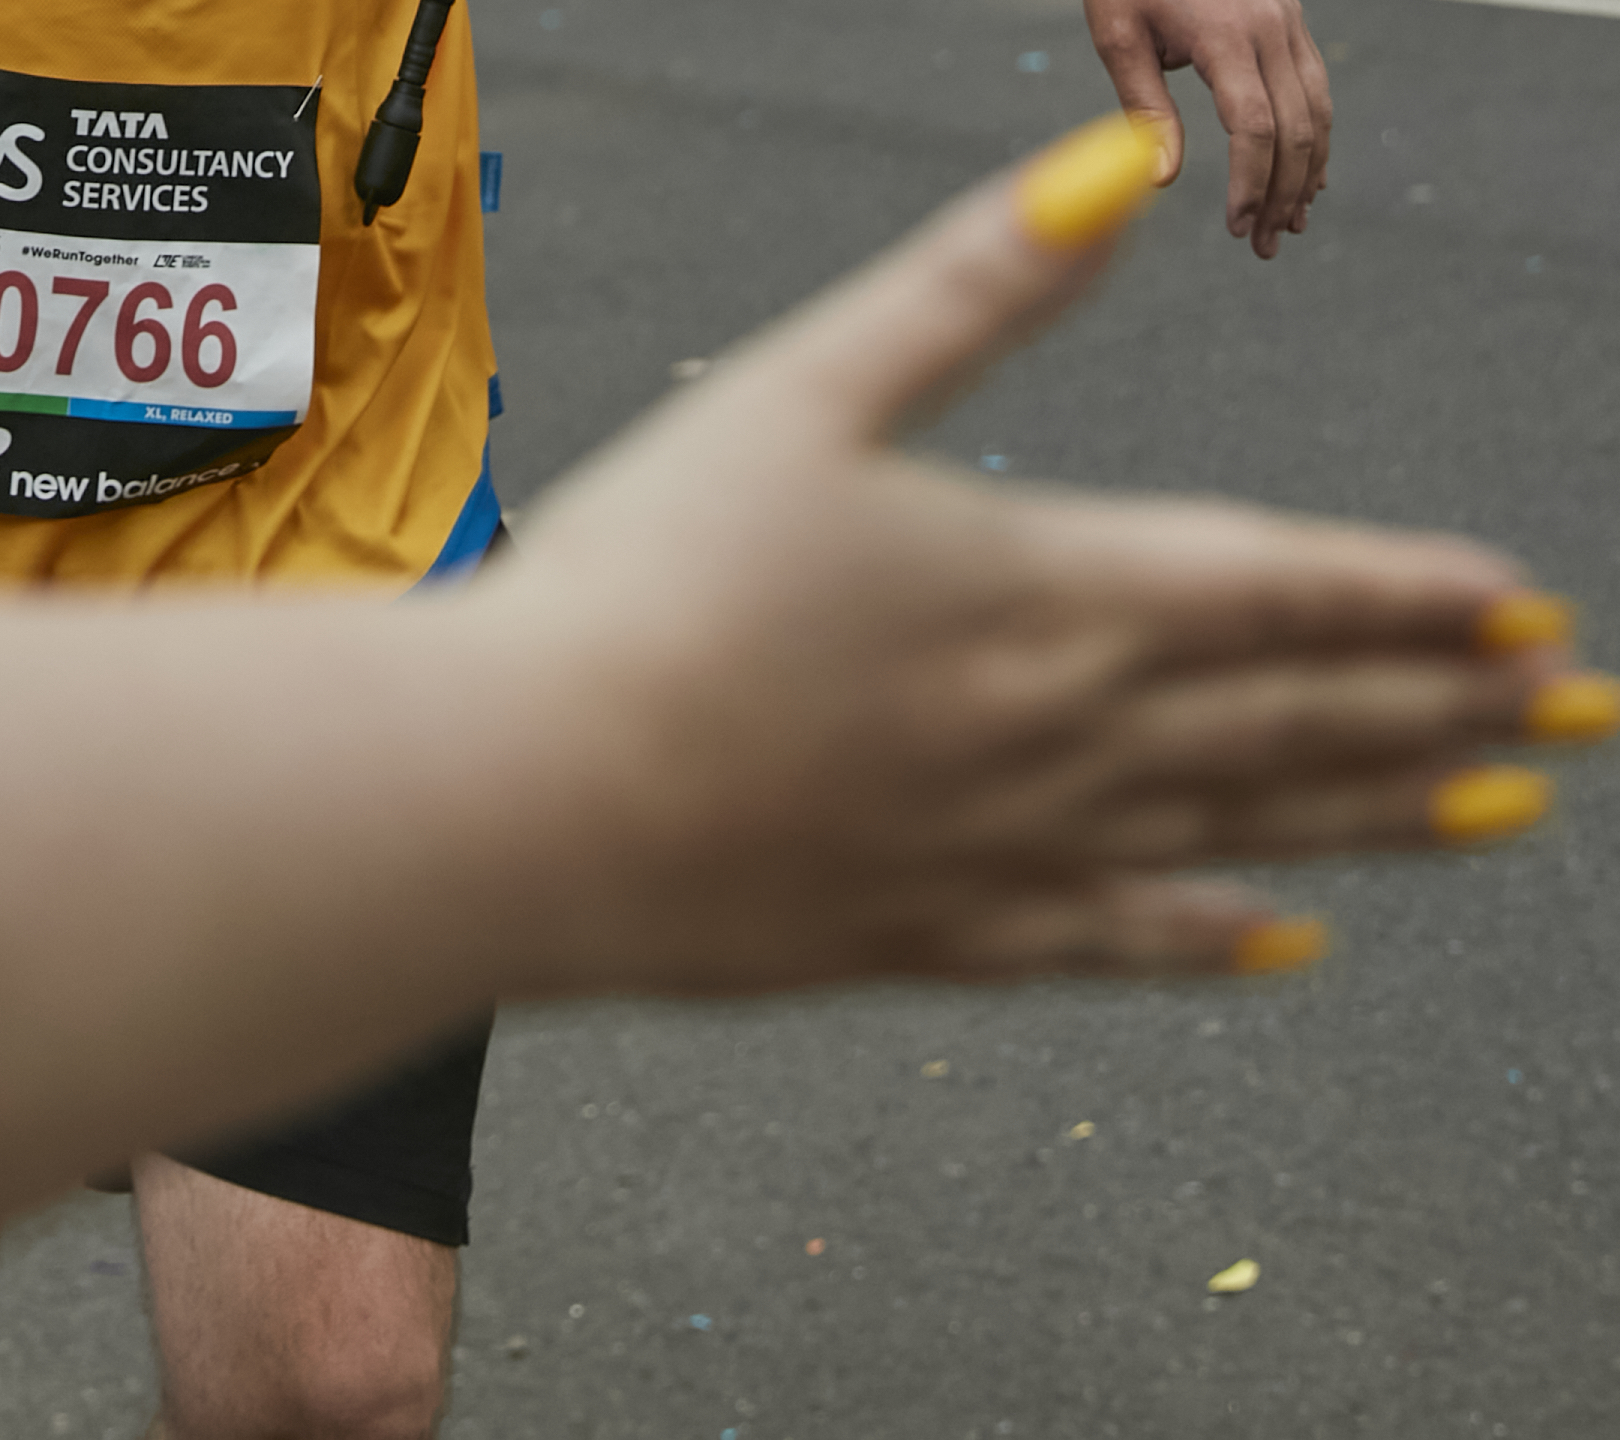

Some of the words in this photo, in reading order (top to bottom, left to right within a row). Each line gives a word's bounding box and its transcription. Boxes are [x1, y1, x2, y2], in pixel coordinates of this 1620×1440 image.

[70, 109, 169, 139] TATA
[66, 145, 294, 179] CONSULTANCY
[62, 180, 209, 213] SERVICES
[22, 246, 139, 267] #WeRunTogether
[170, 406, 234, 425] RELAXED
[9, 470, 90, 502] new
[96, 460, 240, 504] balance
